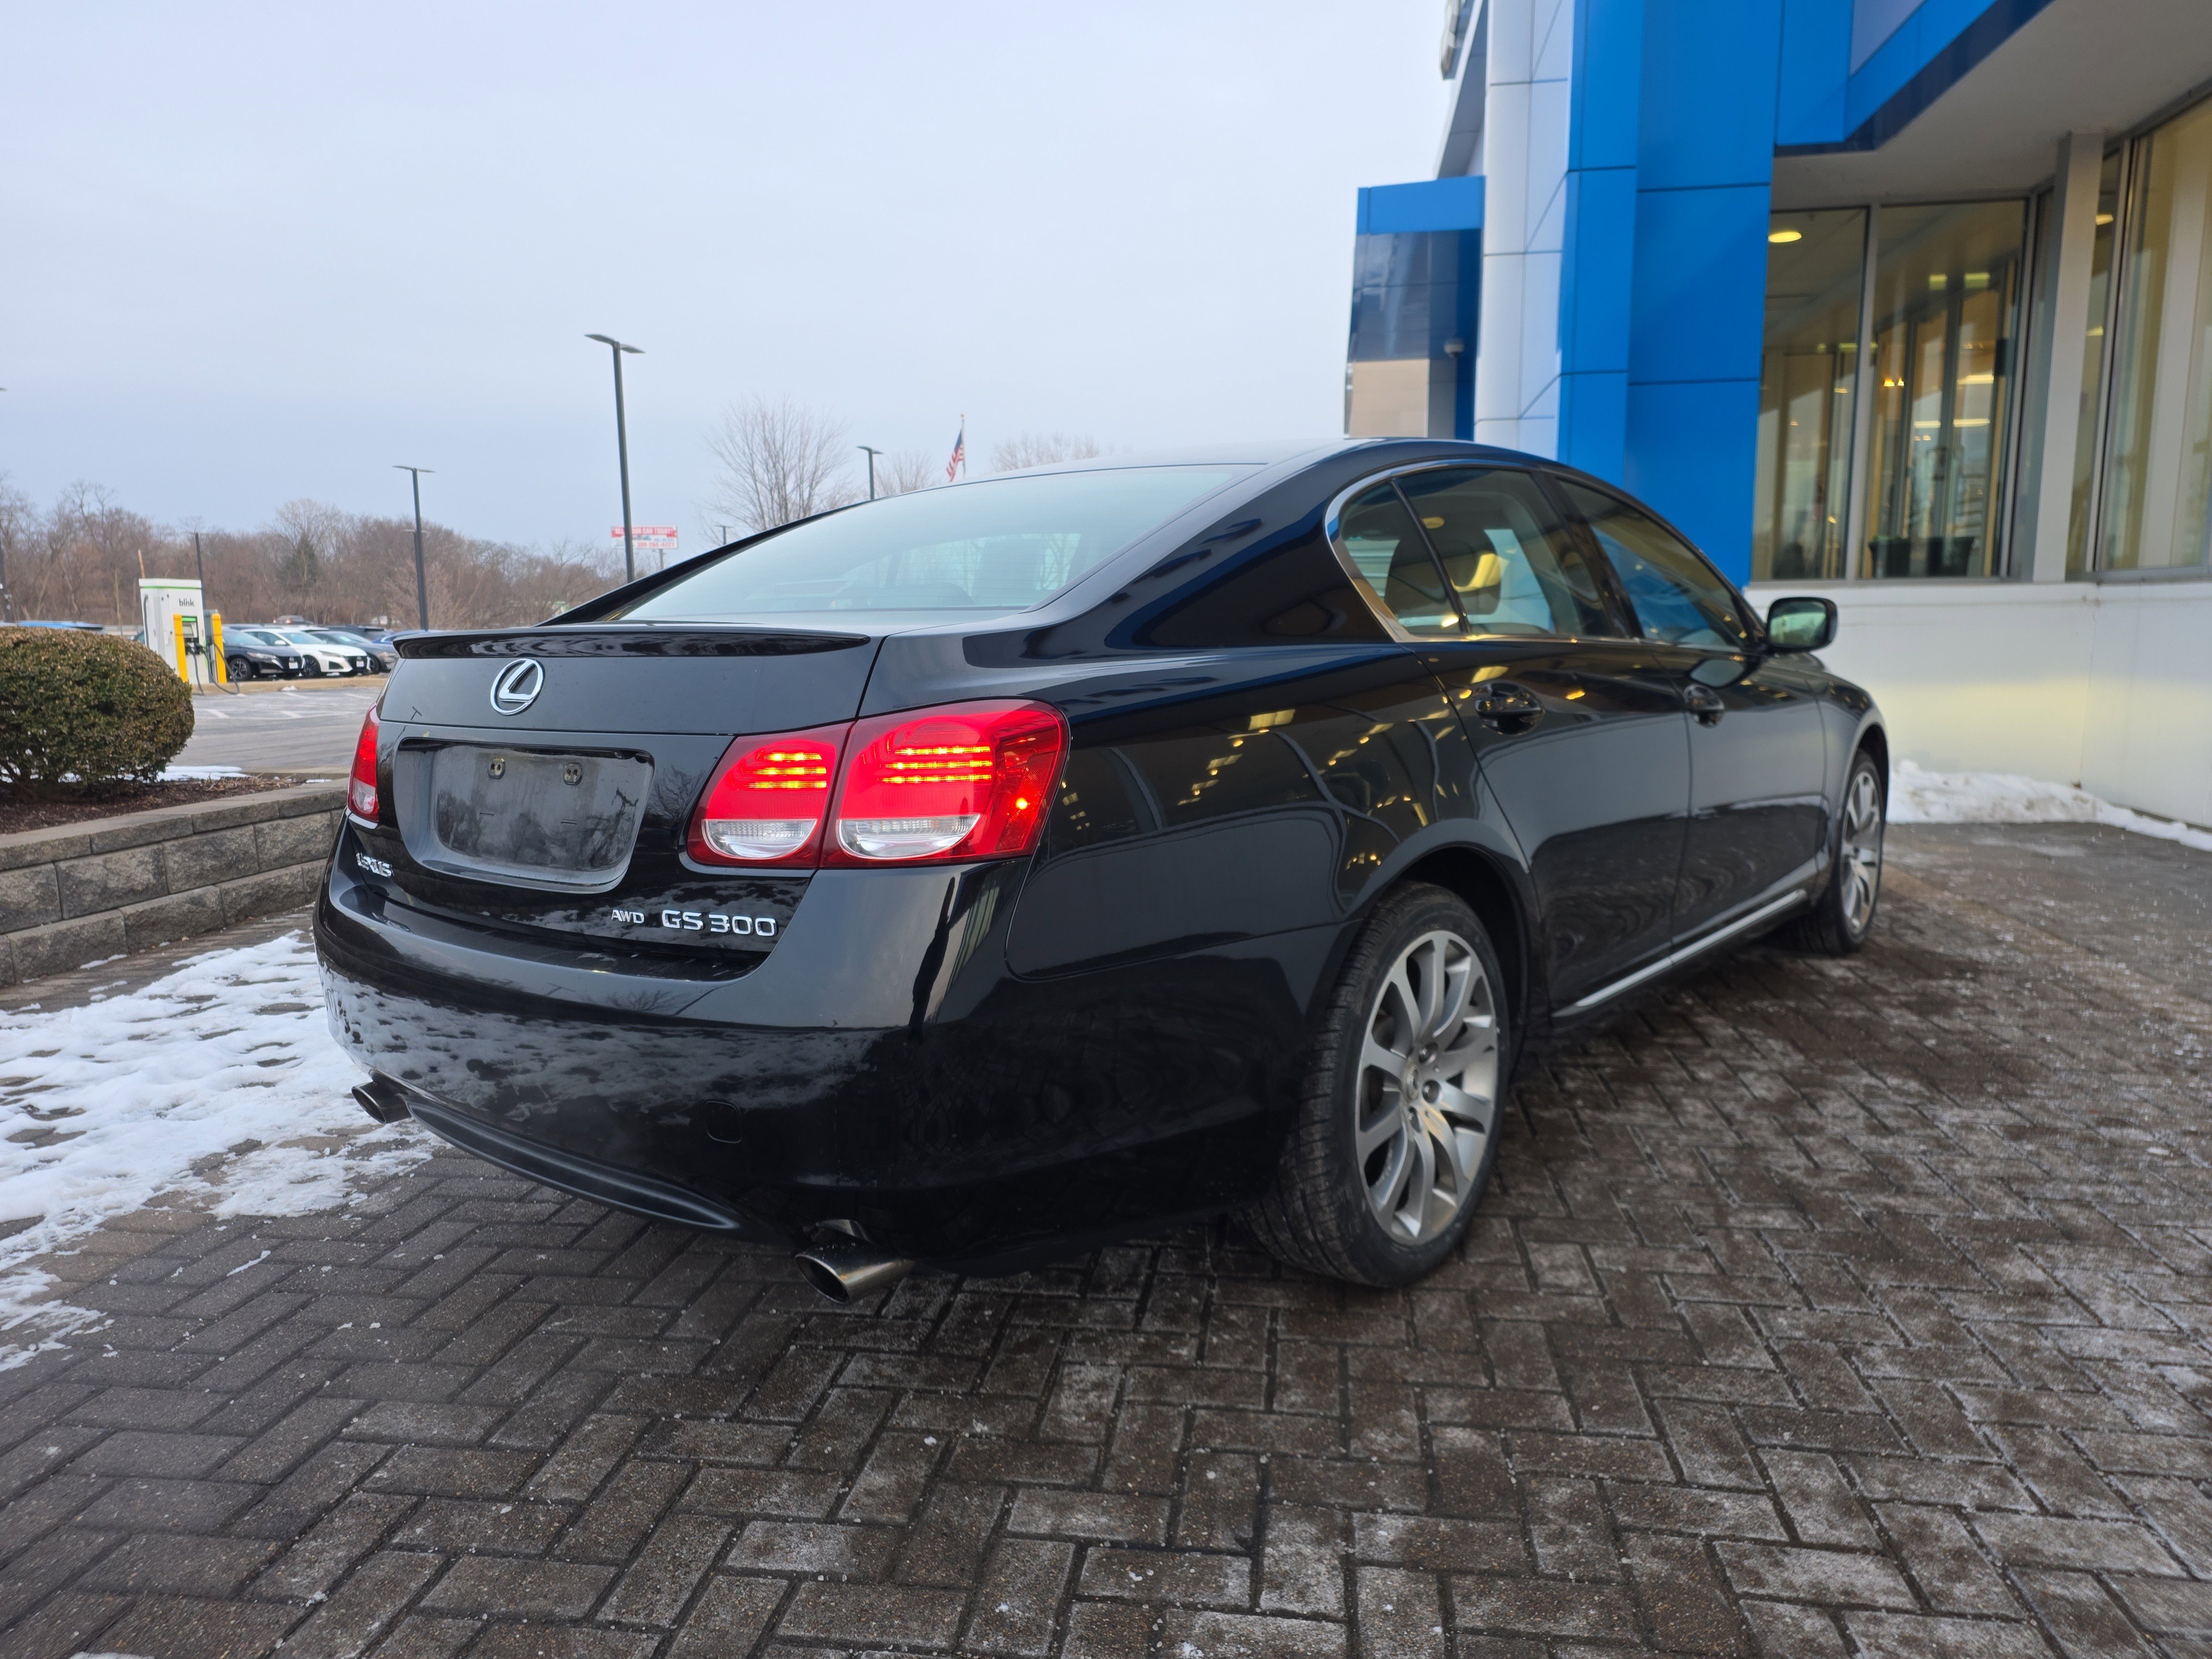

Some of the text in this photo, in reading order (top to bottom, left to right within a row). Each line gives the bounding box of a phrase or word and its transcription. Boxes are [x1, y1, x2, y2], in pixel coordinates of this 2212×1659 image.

[611, 909, 778, 937] AWD GS 300
